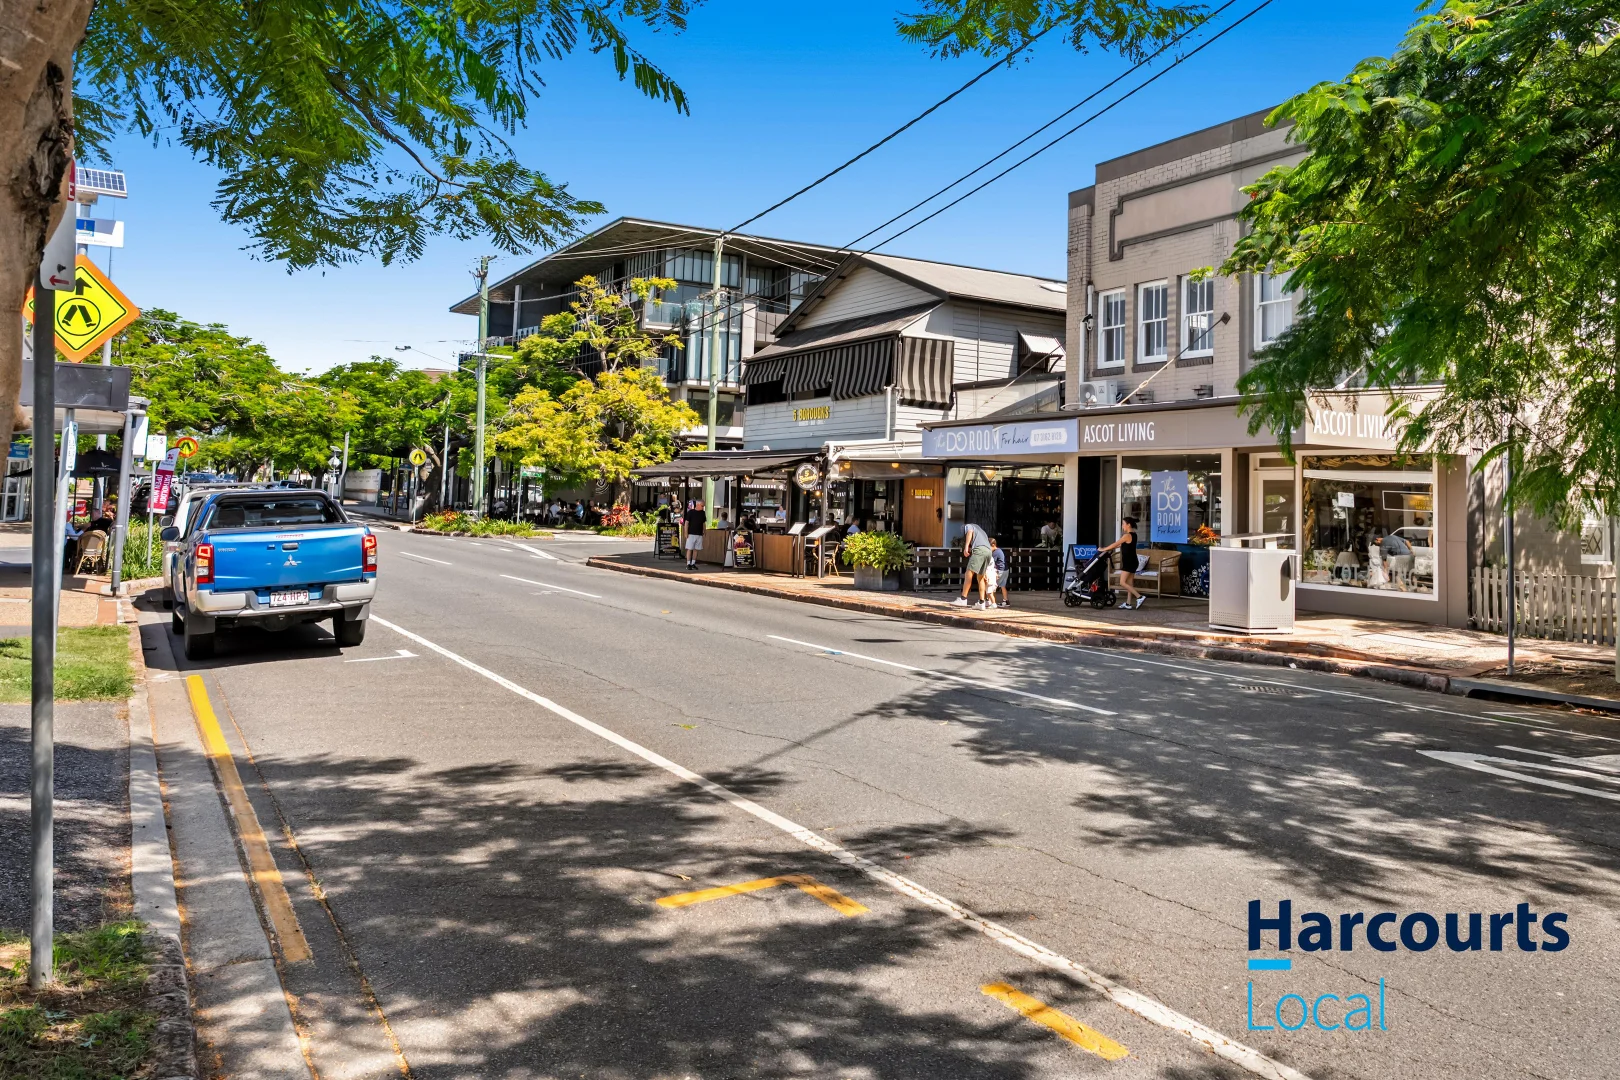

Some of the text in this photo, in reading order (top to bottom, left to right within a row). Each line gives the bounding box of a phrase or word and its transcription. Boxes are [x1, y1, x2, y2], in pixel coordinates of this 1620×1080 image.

[1084, 421, 1155, 443] ASCOT LIVING
[1313, 410, 1353, 437] ASCOT
[946, 431, 968, 451] DO
[970, 427, 1001, 451] ROOM
[1012, 427, 1030, 445] hair
[1157, 492, 1182, 511] DO
[1157, 512, 1181, 527] ROOM
